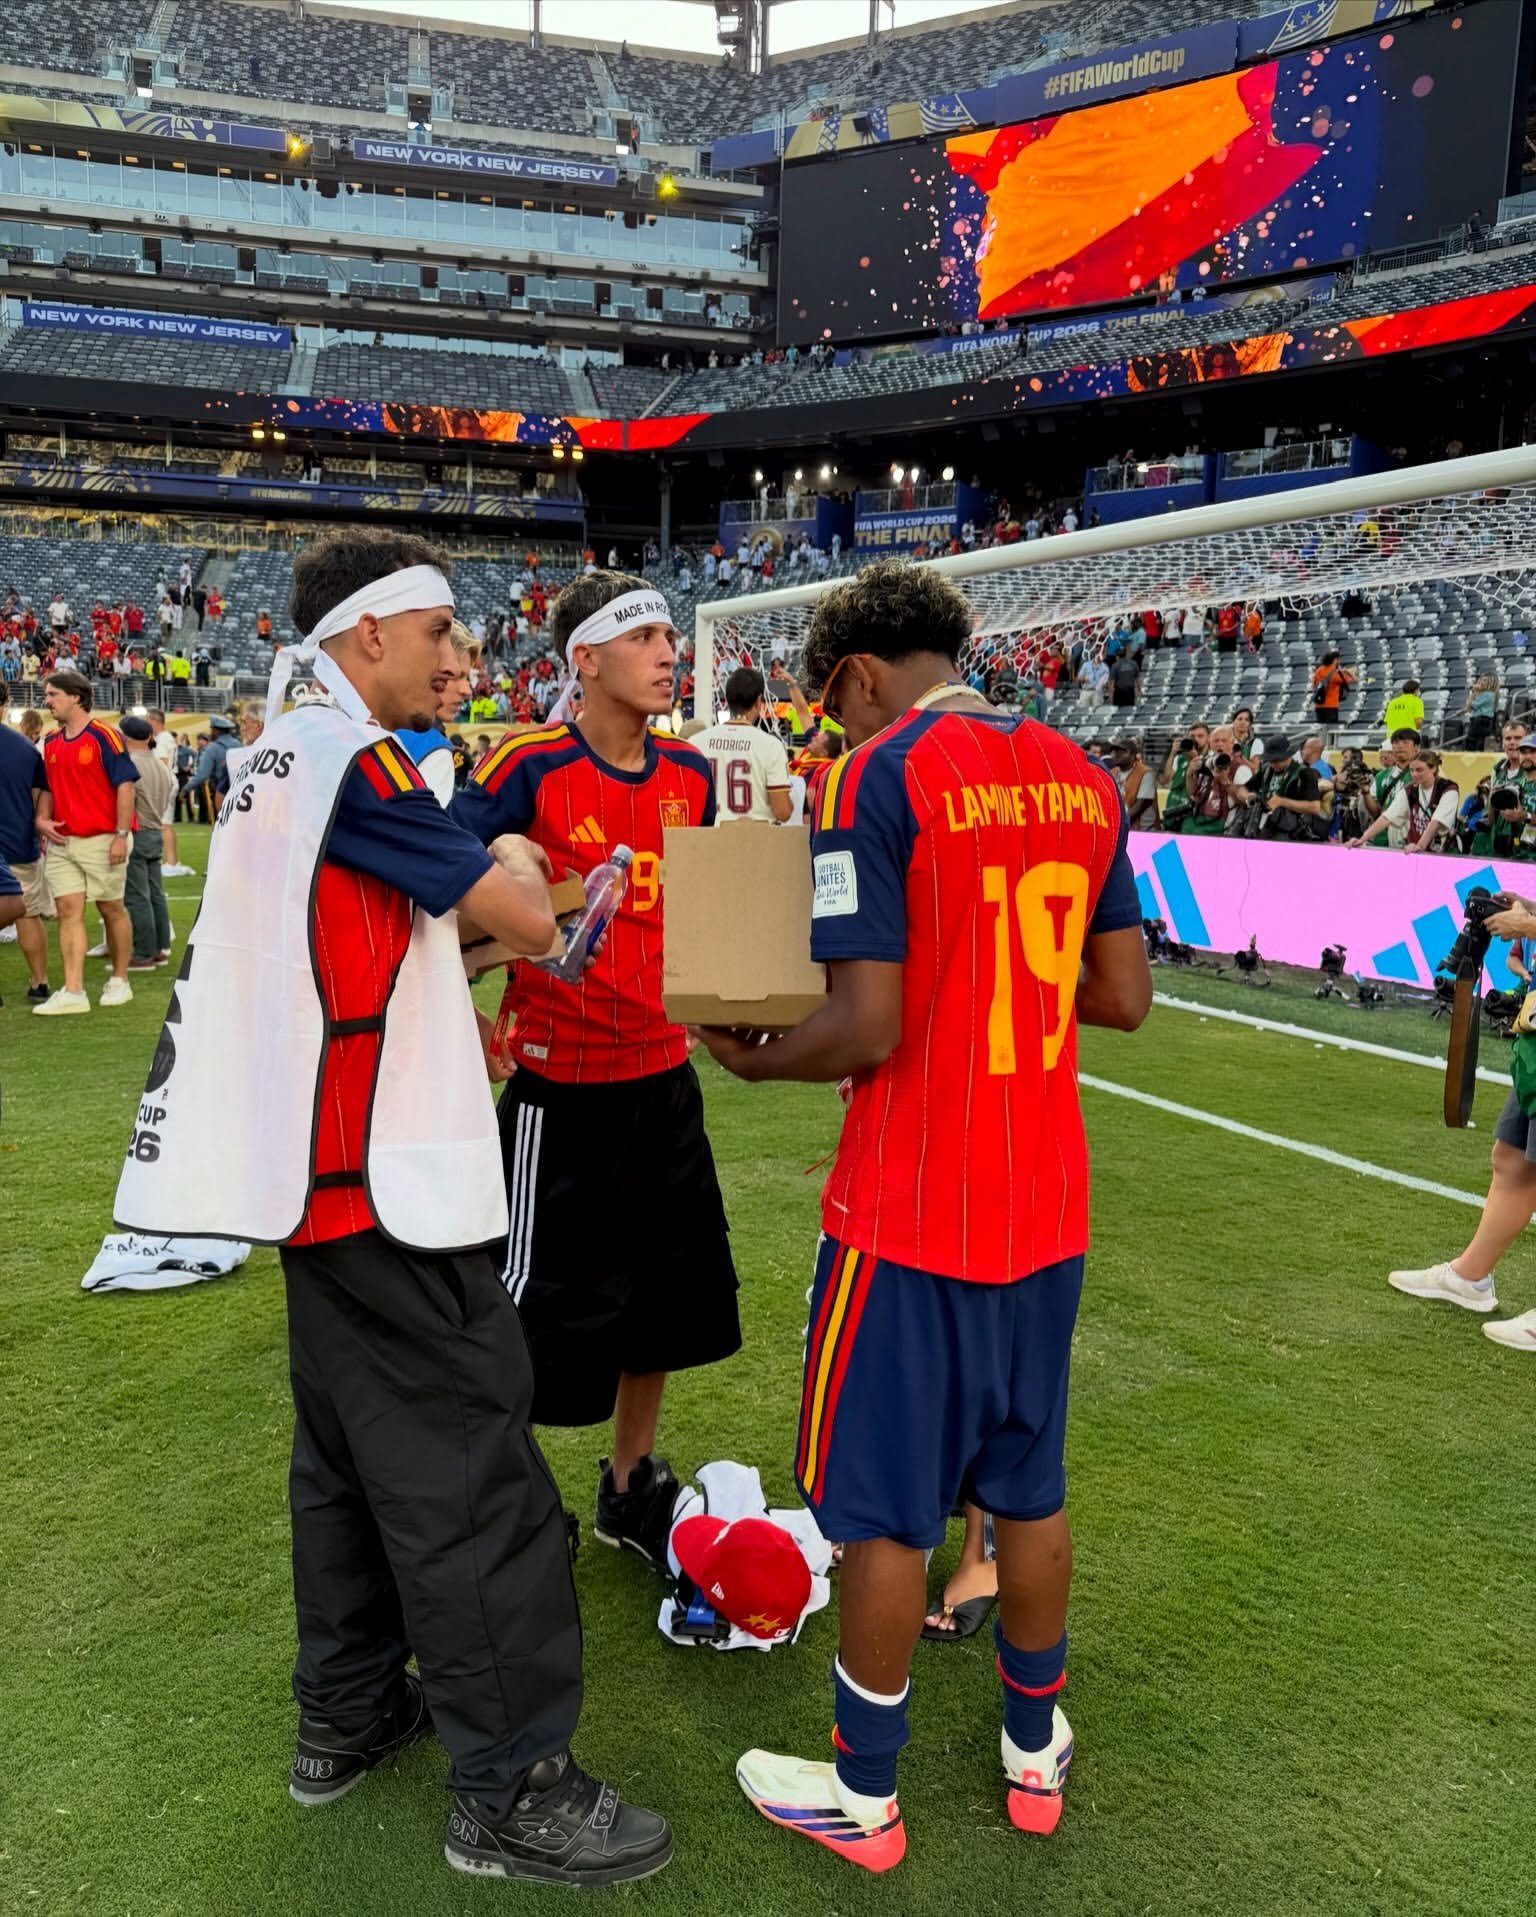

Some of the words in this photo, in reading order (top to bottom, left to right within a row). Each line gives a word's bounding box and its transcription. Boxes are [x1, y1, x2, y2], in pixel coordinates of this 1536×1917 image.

[1043, 48, 1185, 99] #FIFAWorldCup
[366, 143, 415, 159] NEW
[417, 149, 473, 167] YORK
[477, 157, 523, 172] NEW
[527, 163, 605, 181] JERSEY
[30, 309, 80, 323] NEW
[85, 313, 144, 330] YORK
[148, 319, 197, 334] NEW
[200, 325, 282, 343] JERSEY
[1027, 329, 1053, 343] CUP
[1053, 322, 1100, 339] 2026
[873, 518, 904, 529] WORLD
[905, 517, 923, 526] CUP
[855, 529, 892, 546] THE
[614, 603, 645, 624] MADE
[645, 602, 654, 613] IN
[709, 738, 752, 752] RODRIGO
[941, 782, 1026, 833] LAMINE
[1026, 782, 1109, 829] YAMAL
[982, 861, 1090, 1077] 19
